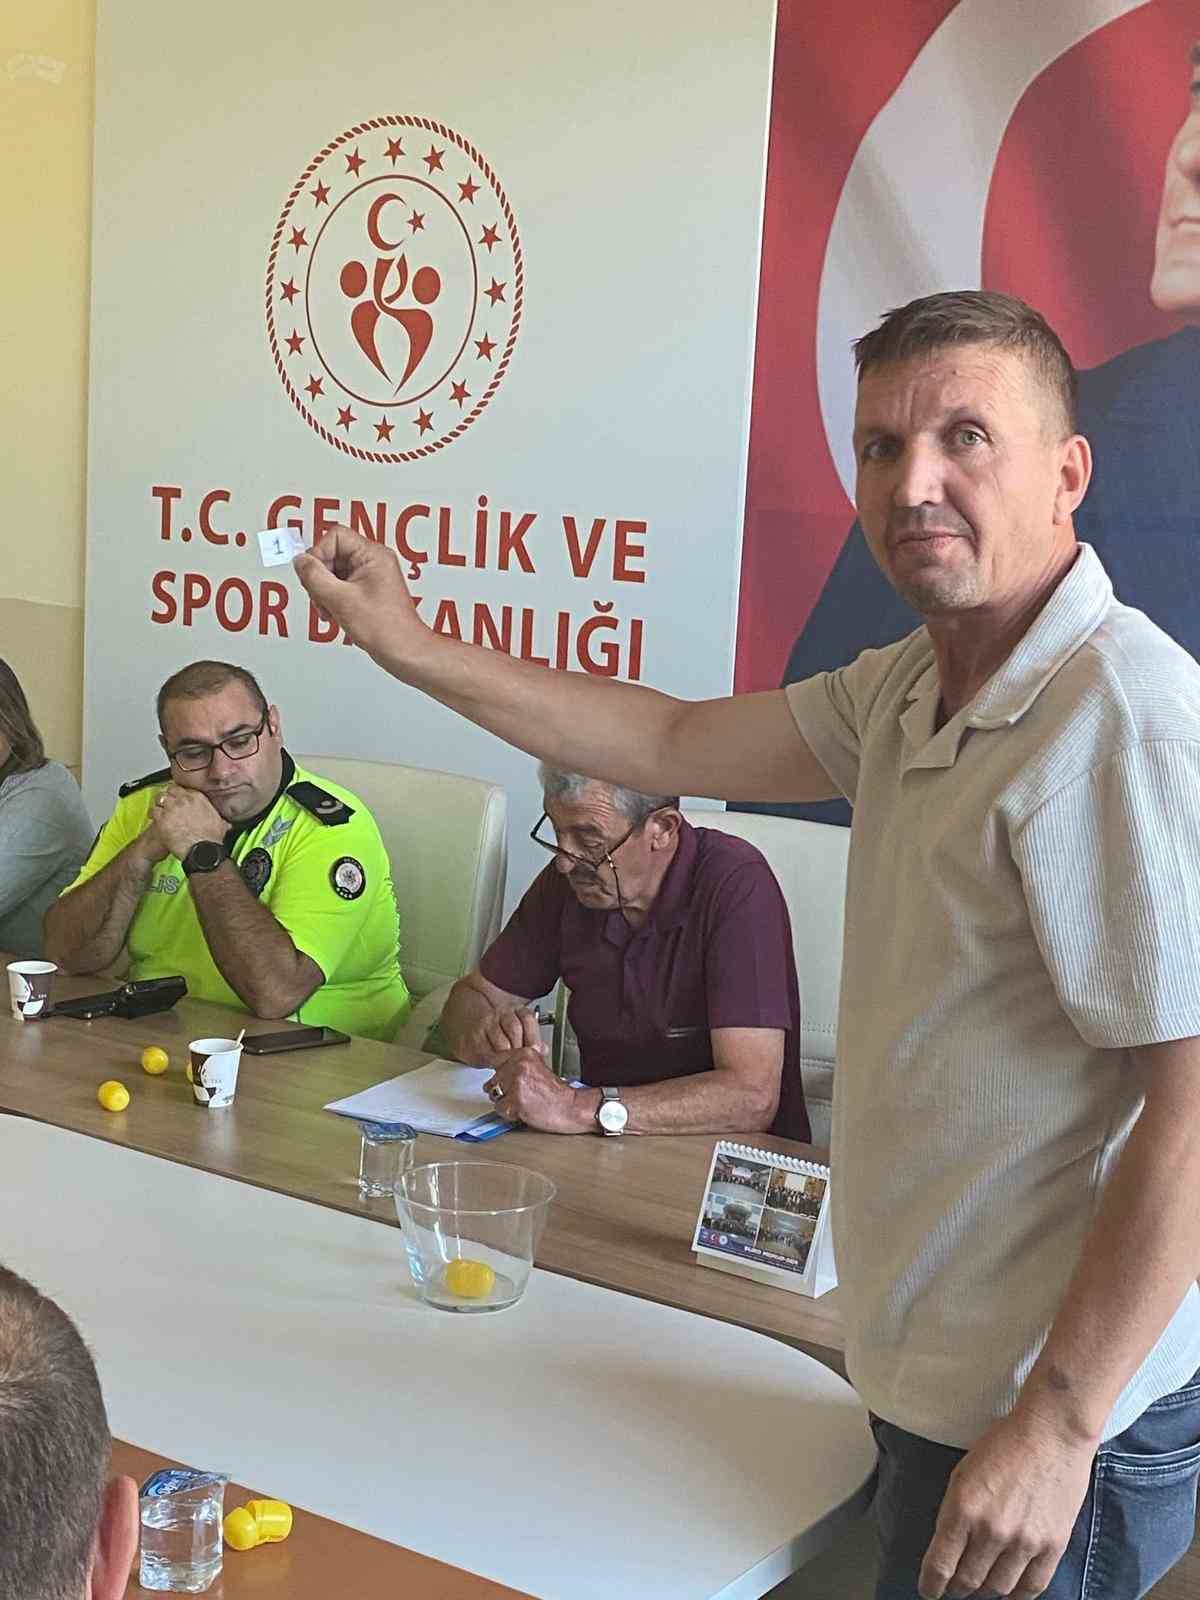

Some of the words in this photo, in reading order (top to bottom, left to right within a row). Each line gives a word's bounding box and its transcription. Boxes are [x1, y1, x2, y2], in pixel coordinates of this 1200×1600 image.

[152, 486, 246, 547] T.C.
[563, 515, 648, 584] VE
[272, 538, 284, 555] 1
[151, 570, 290, 638] SPOR
[308, 596, 644, 681] BANLIĞI
